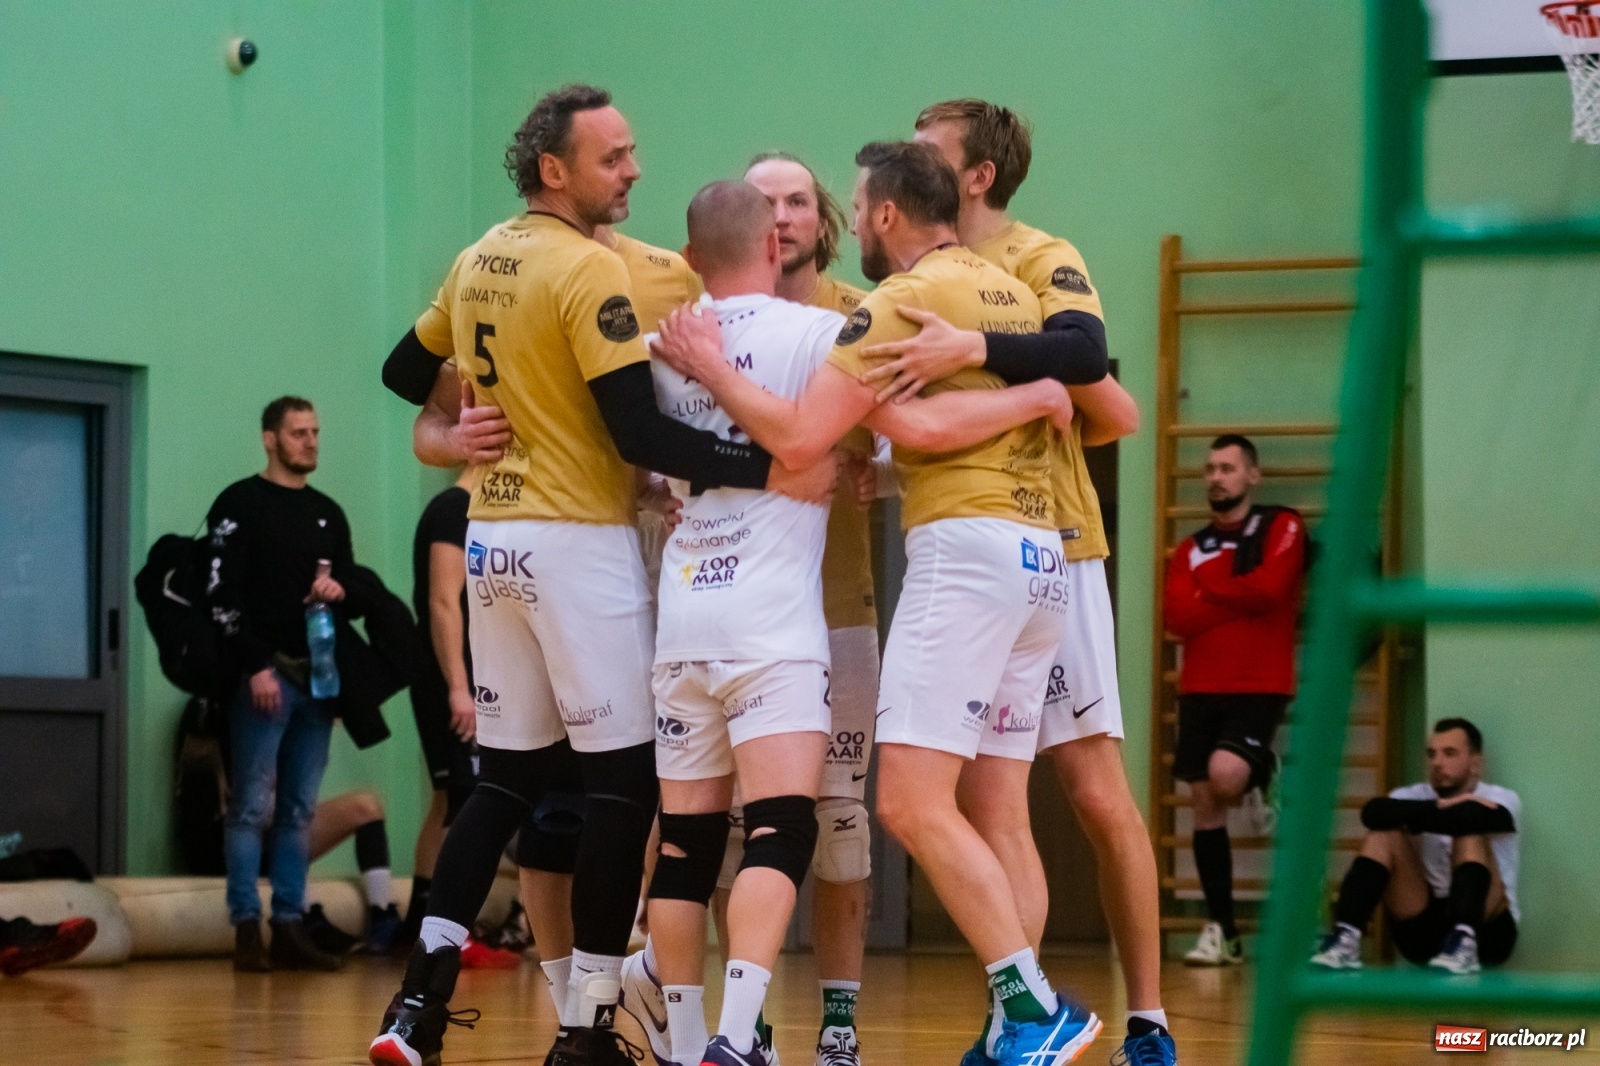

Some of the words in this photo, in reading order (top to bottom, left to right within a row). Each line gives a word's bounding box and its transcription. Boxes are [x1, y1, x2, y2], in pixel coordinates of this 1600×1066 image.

[472, 254, 523, 277] PYCIEK
[978, 289, 1020, 308] KUBA
[474, 321, 499, 388] 5
[490, 471, 525, 488] ZOO
[487, 487, 522, 502] MAR
[490, 547, 535, 579] DK
[699, 555, 739, 574] ZOO
[691, 569, 735, 587] MAR
[475, 571, 538, 608] glass
